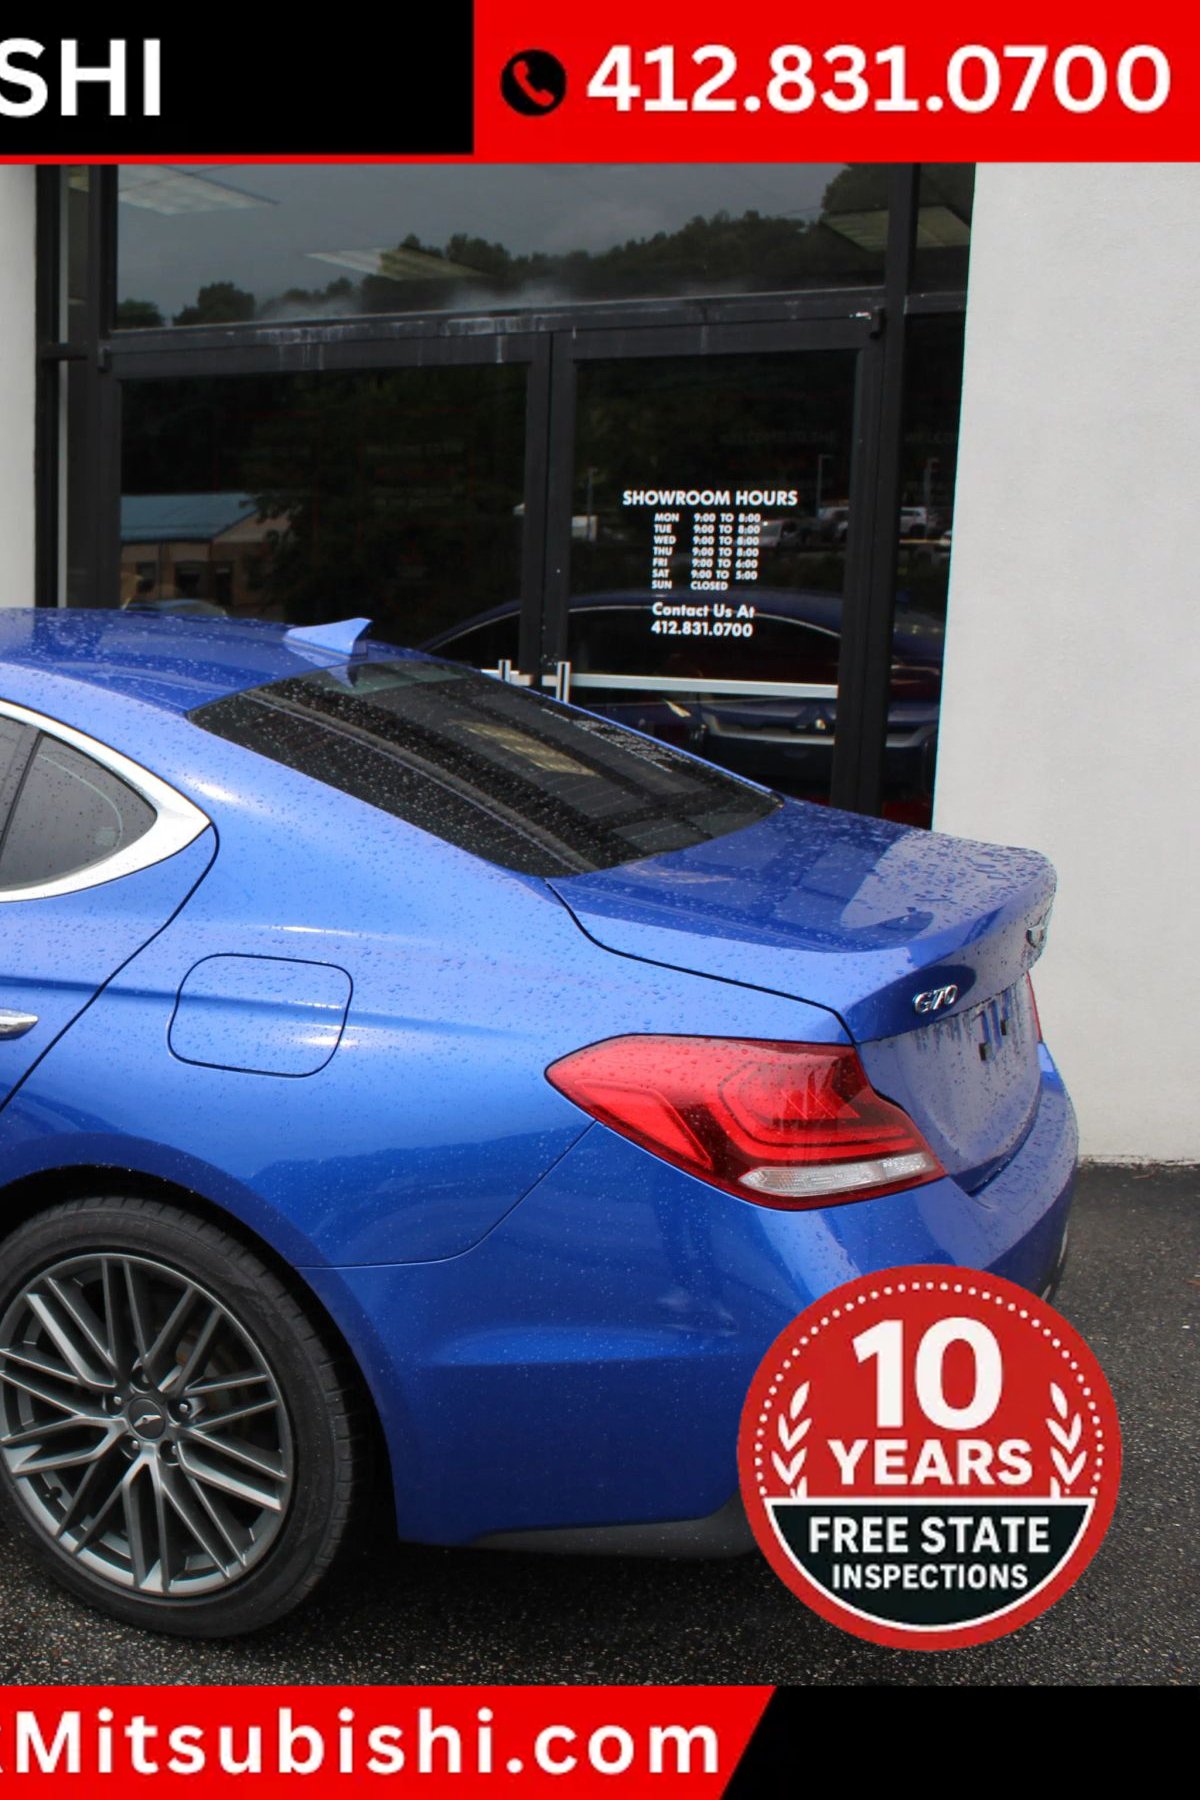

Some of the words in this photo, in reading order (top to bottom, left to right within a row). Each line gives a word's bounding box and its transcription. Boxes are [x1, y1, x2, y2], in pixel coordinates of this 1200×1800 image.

[622, 489, 731, 506] SHOWROOM
[735, 489, 798, 506] HOURS
[654, 513, 679, 522] MON
[693, 513, 716, 522] 9:00
[720, 513, 734, 522] TO
[738, 513, 761, 522] 8:00
[654, 524, 672, 533] TUE
[693, 525, 715, 534] 9:00
[719, 525, 733, 534] TO
[738, 525, 760, 534] 8:00
[654, 536, 676, 545] WED
[693, 536, 714, 545] 9:00
[719, 536, 733, 545] TO
[736, 536, 759, 545] 8:00
[653, 547, 673, 556] THU
[692, 547, 714, 556] 9:00
[719, 548, 732, 556] TO
[736, 548, 759, 557] 8:00
[653, 558, 668, 567] FRI
[692, 559, 713, 568] 9:00
[717, 559, 731, 568] TO
[735, 559, 758, 568] 6:00
[652, 569, 669, 578] SAT
[691, 570, 712, 579] 9:00
[716, 570, 729, 579] TO
[735, 571, 758, 580] 5:00
[652, 580, 672, 589] SUN
[691, 581, 728, 590] CLOSED
[652, 602, 710, 617] Contact
[713, 603, 733, 618] Us
[736, 604, 755, 618] At
[651, 620, 753, 638] 412.831.0700
[913, 984, 958, 1013] G70
